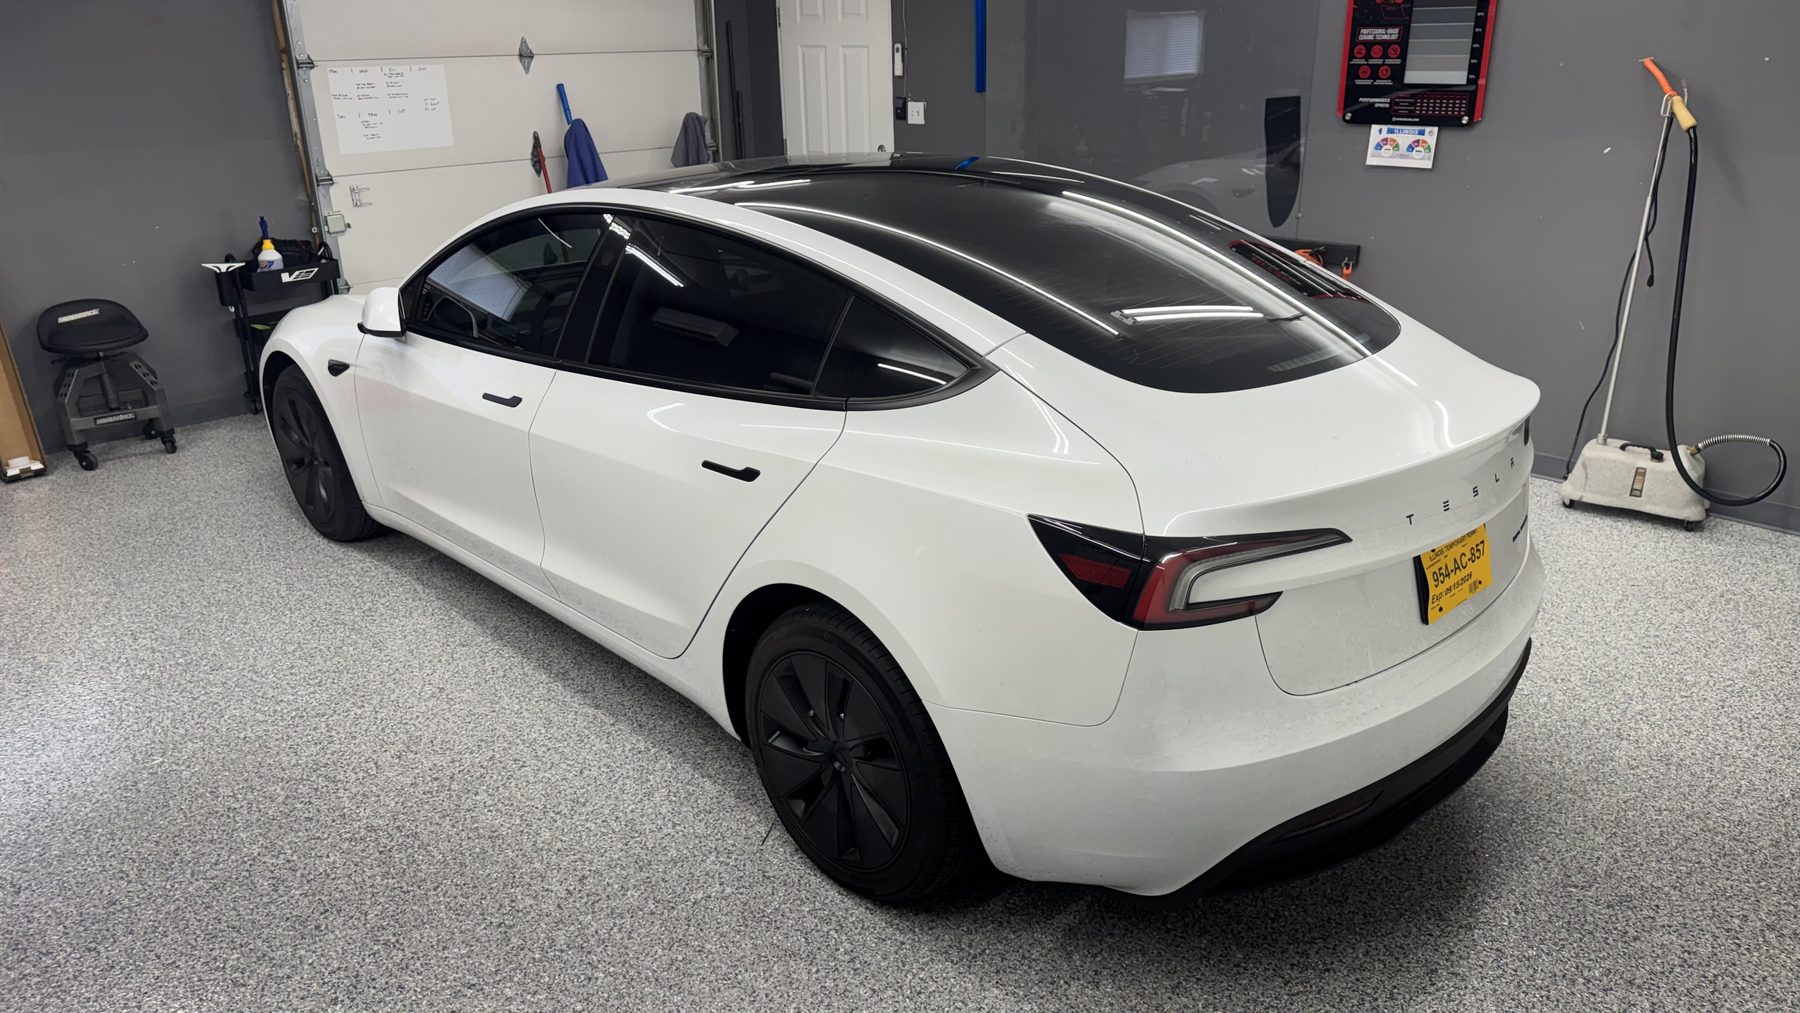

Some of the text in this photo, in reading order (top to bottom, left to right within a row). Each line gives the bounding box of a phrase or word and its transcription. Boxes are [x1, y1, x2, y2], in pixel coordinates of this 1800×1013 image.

[1429, 548, 1444, 562] ILLINOIS
[1444, 535, 1466, 552] TEMPORARY
[1432, 539, 1485, 588] 954-AC-857
